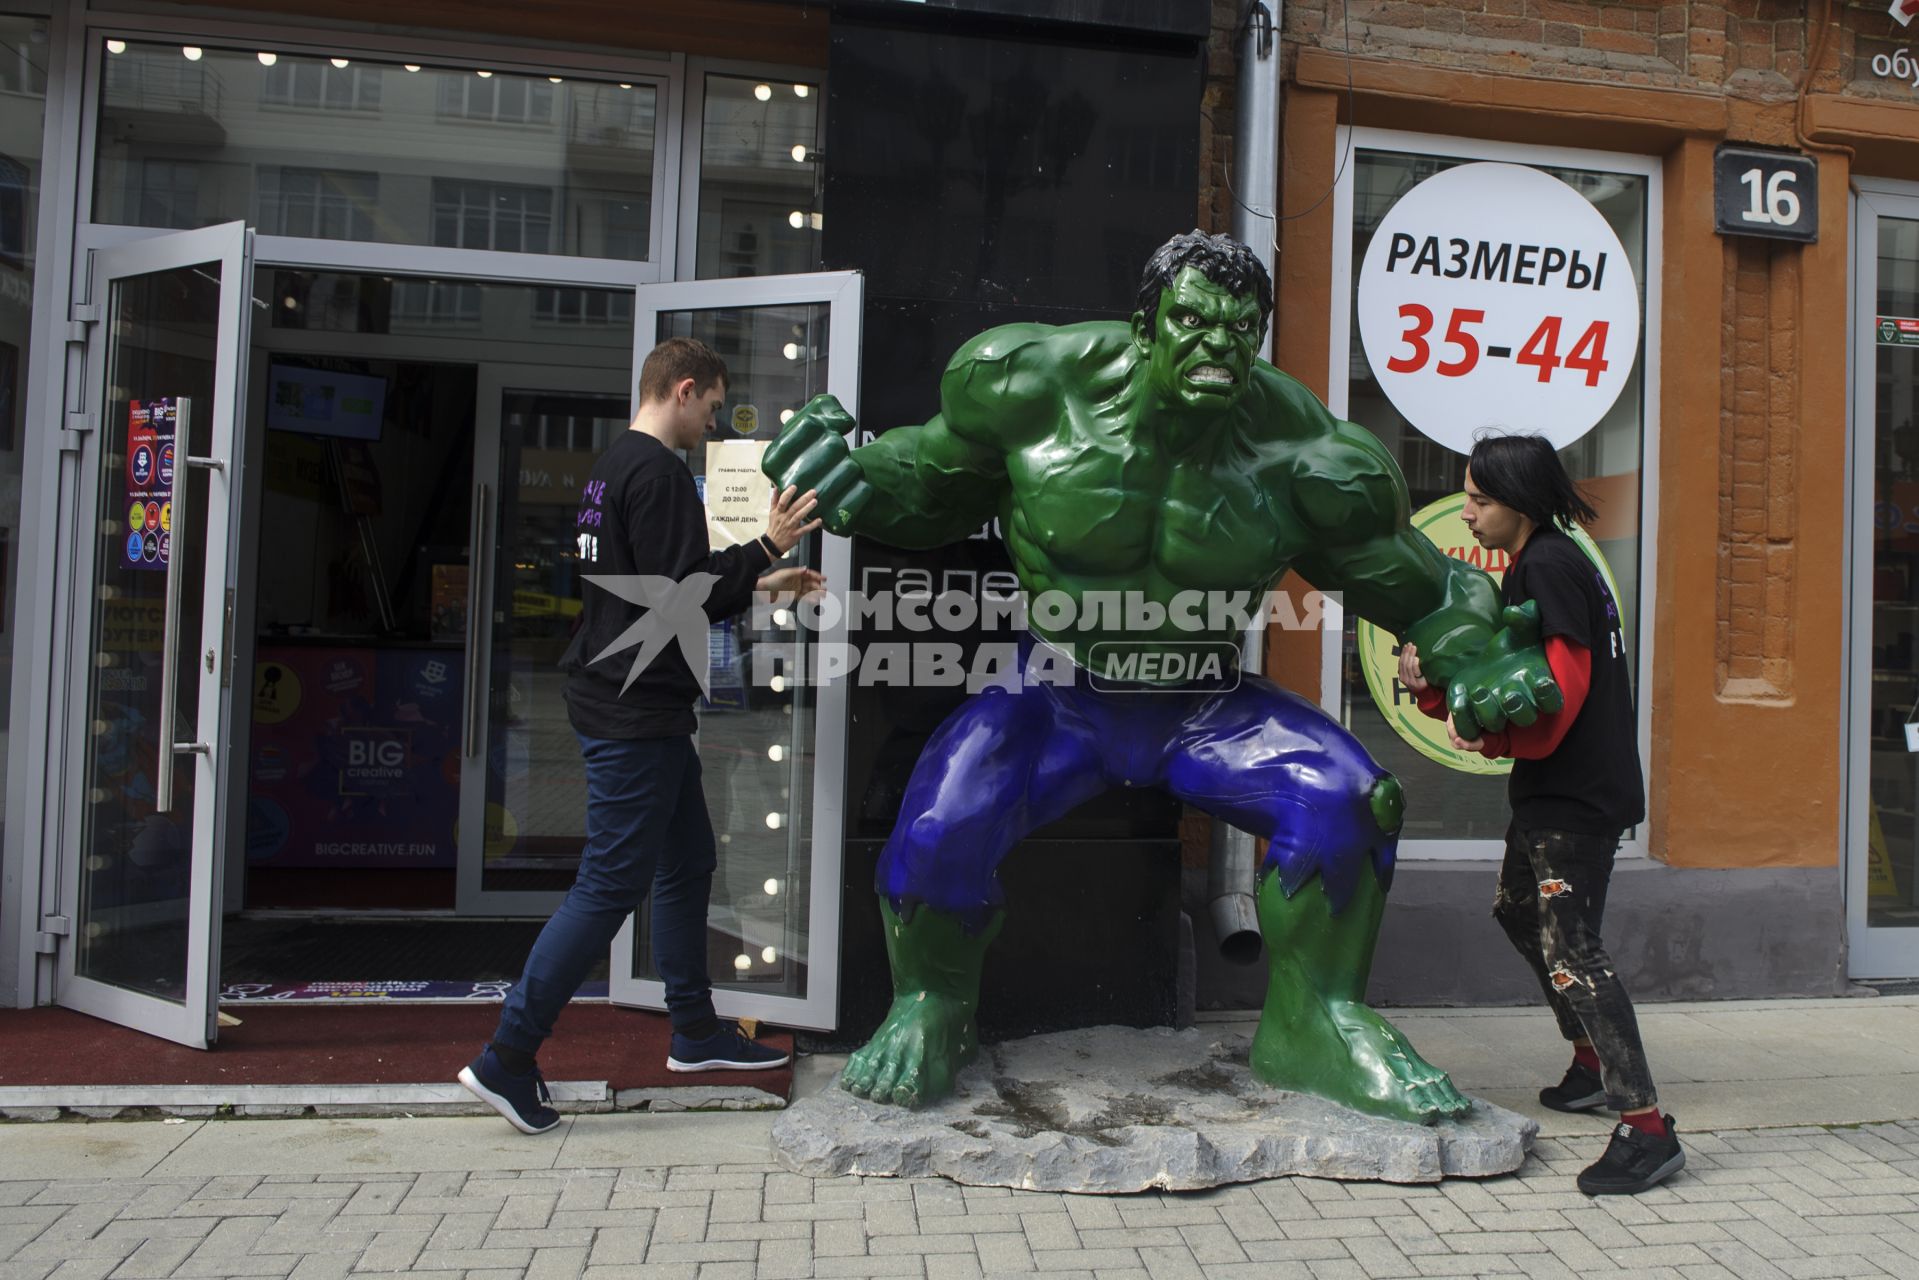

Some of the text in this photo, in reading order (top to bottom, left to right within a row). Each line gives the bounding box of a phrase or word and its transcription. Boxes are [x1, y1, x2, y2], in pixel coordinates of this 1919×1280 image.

[1740, 168, 1801, 226] 16
[1386, 232, 1607, 291] РАЗМЕРЫ
[1386, 302, 1610, 388] 35-44
[347, 766, 403, 778] creative
[348, 740, 404, 766] BIG
[315, 843, 436, 856] BIGCREATIVE.FUN
